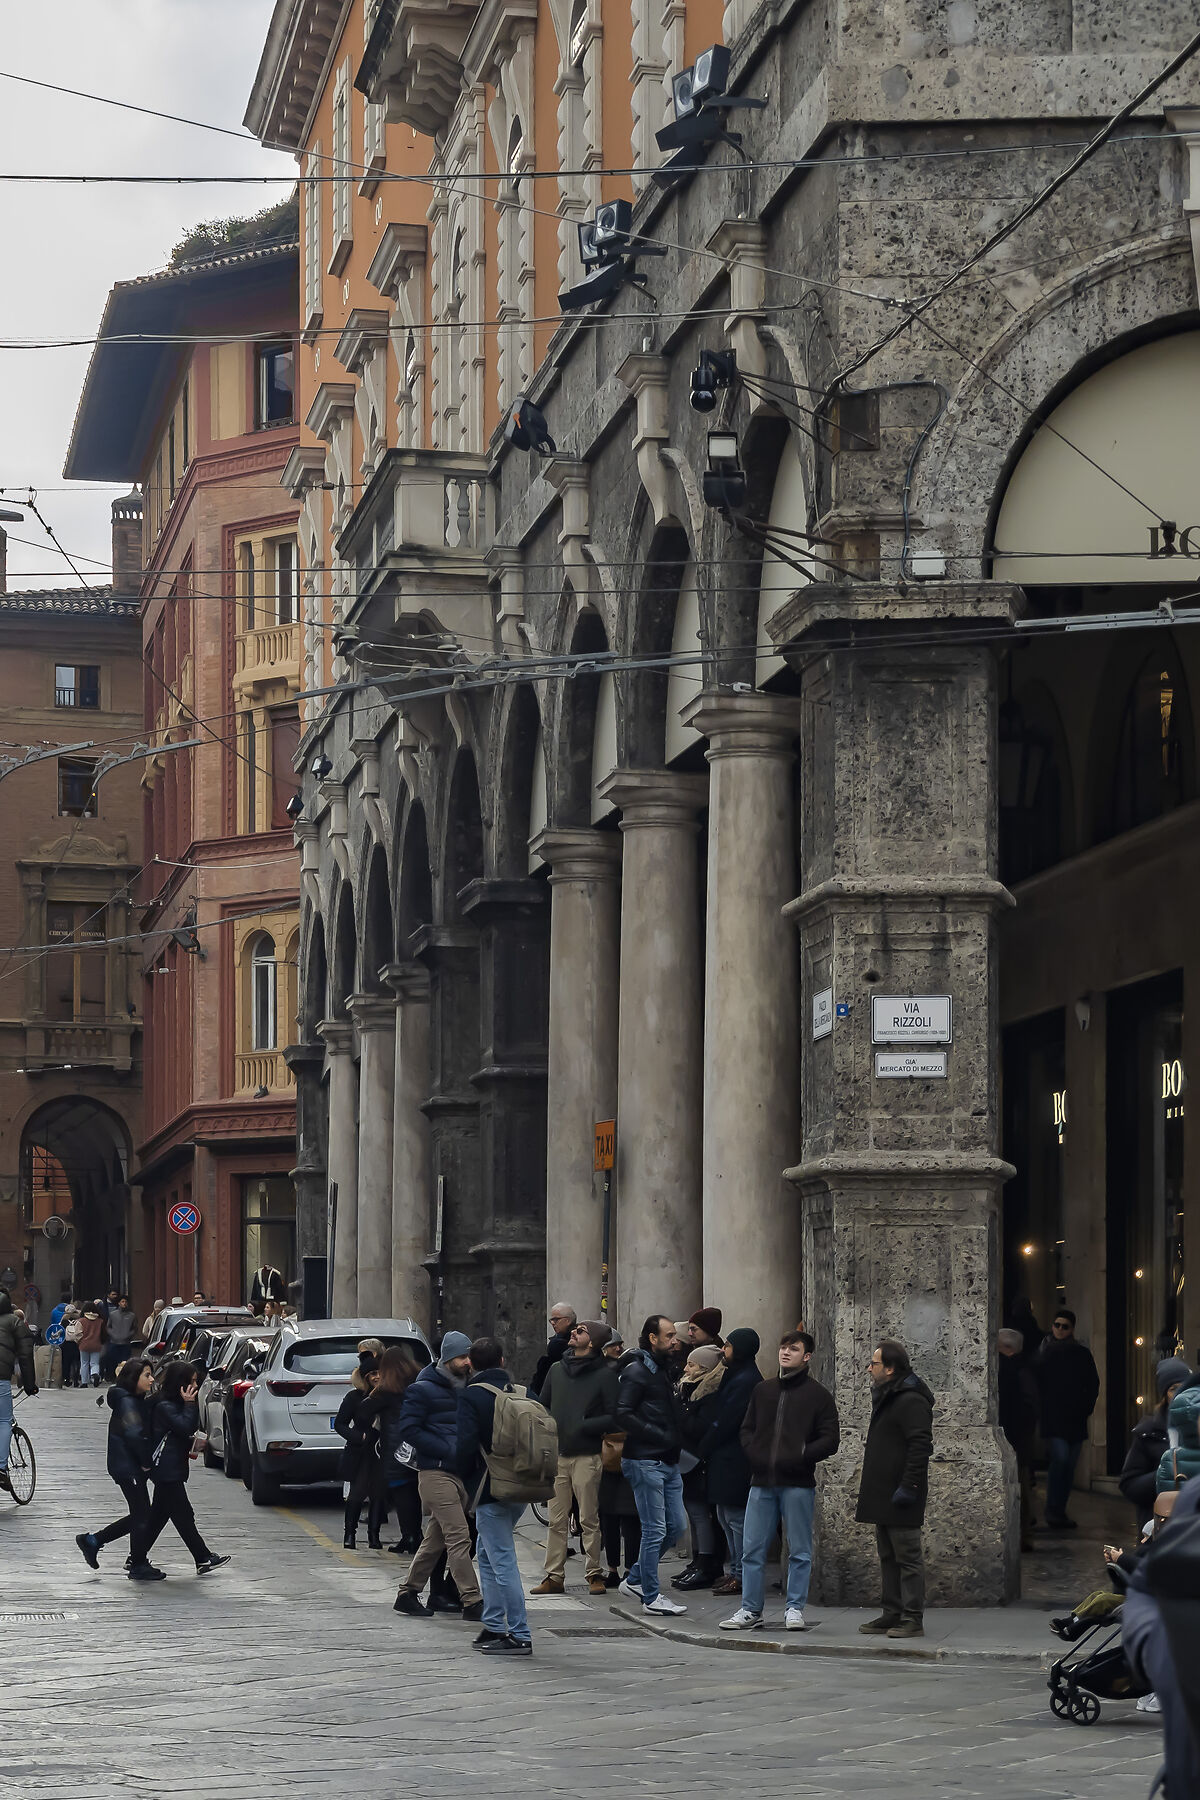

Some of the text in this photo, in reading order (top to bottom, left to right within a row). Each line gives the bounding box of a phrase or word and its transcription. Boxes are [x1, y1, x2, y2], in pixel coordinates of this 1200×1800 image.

[903, 1002, 920, 1014] VIA
[892, 1016, 932, 1028] RIZZOLI
[596, 1134, 613, 1157] TAXI
